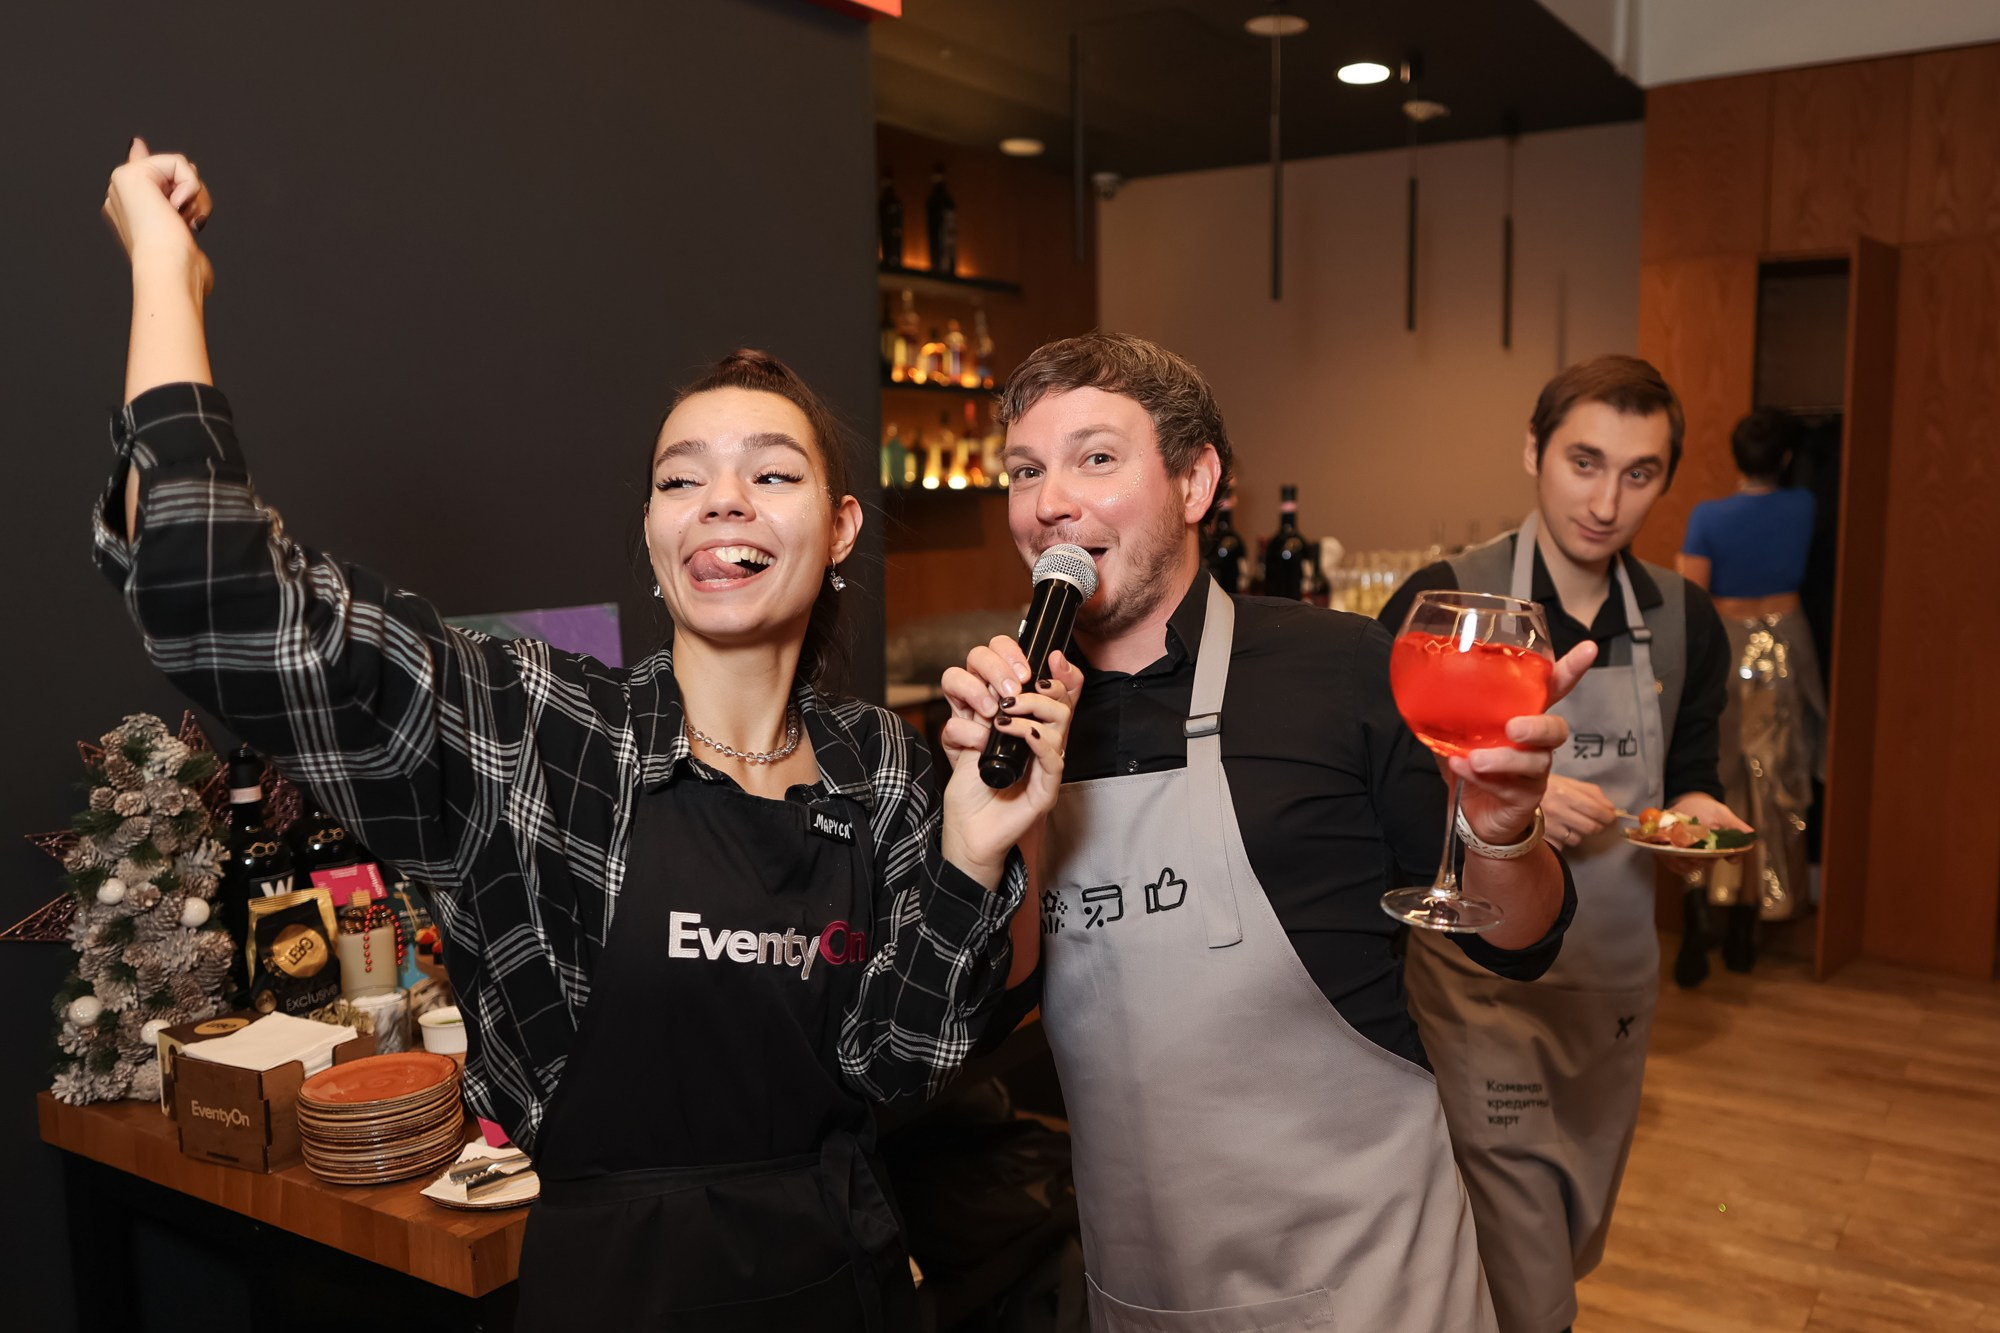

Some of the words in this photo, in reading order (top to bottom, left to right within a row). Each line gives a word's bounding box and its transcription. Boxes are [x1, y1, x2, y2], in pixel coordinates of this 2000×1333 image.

[286, 937, 314, 966] LEBO
[668, 911, 866, 980] EventyOn
[191, 1100, 250, 1127] EventyOn
[1487, 1115, 1520, 1129] карт
